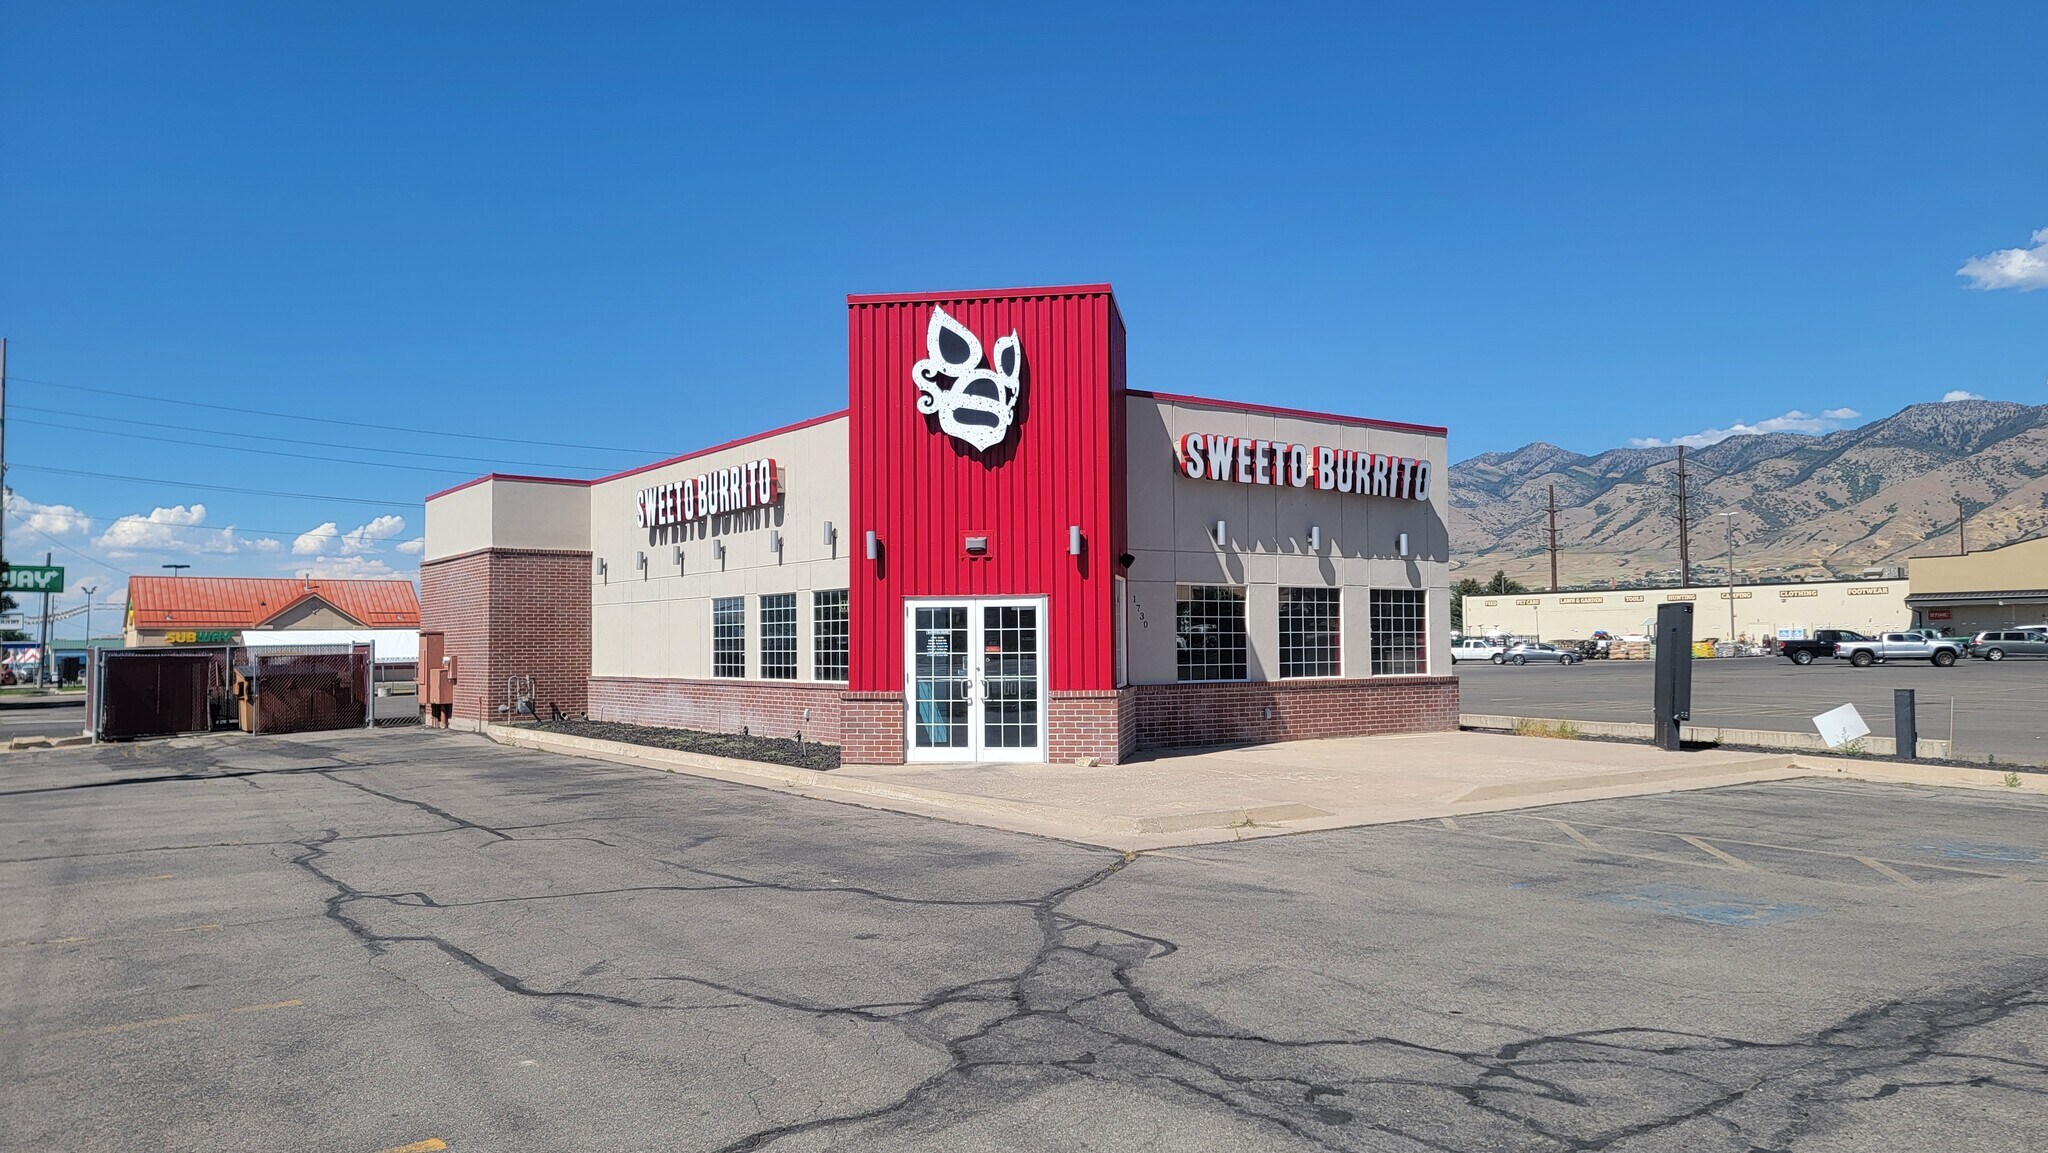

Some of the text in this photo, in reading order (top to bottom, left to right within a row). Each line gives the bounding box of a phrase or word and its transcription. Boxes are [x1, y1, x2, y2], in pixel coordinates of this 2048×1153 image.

[1182, 432, 1432, 502] SWEETO BURRITO
[636, 458, 774, 529] SWEETO BURRITO
[1847, 587, 1889, 595] FOOTWEAR
[1132, 594, 1149, 629] 1730
[163, 630, 235, 643] SUBWAY
